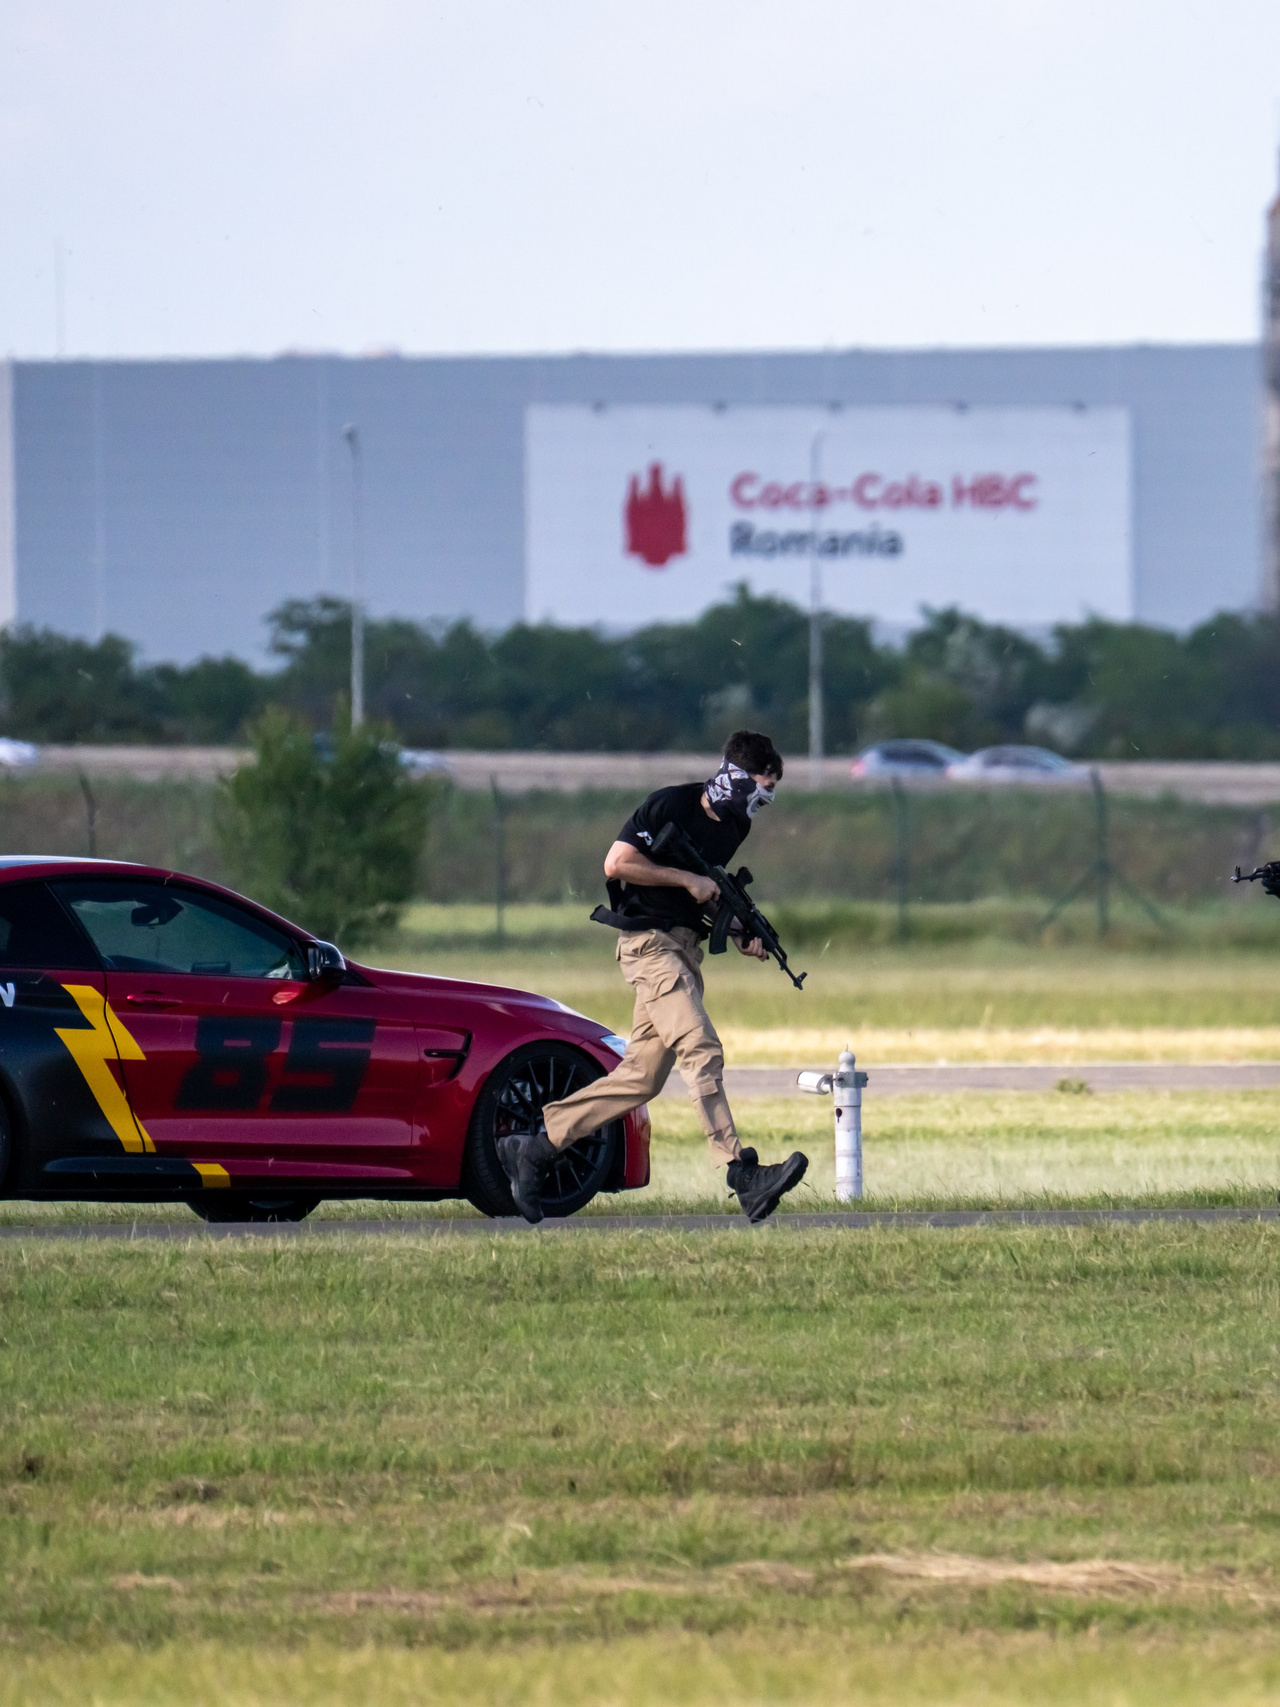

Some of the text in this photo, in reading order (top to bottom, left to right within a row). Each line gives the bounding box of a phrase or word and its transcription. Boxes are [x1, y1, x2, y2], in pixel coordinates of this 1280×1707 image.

[730, 472, 1036, 511] Coca-Cola HBC
[730, 519, 903, 557] Romania
[173, 1015, 377, 1112] 85
